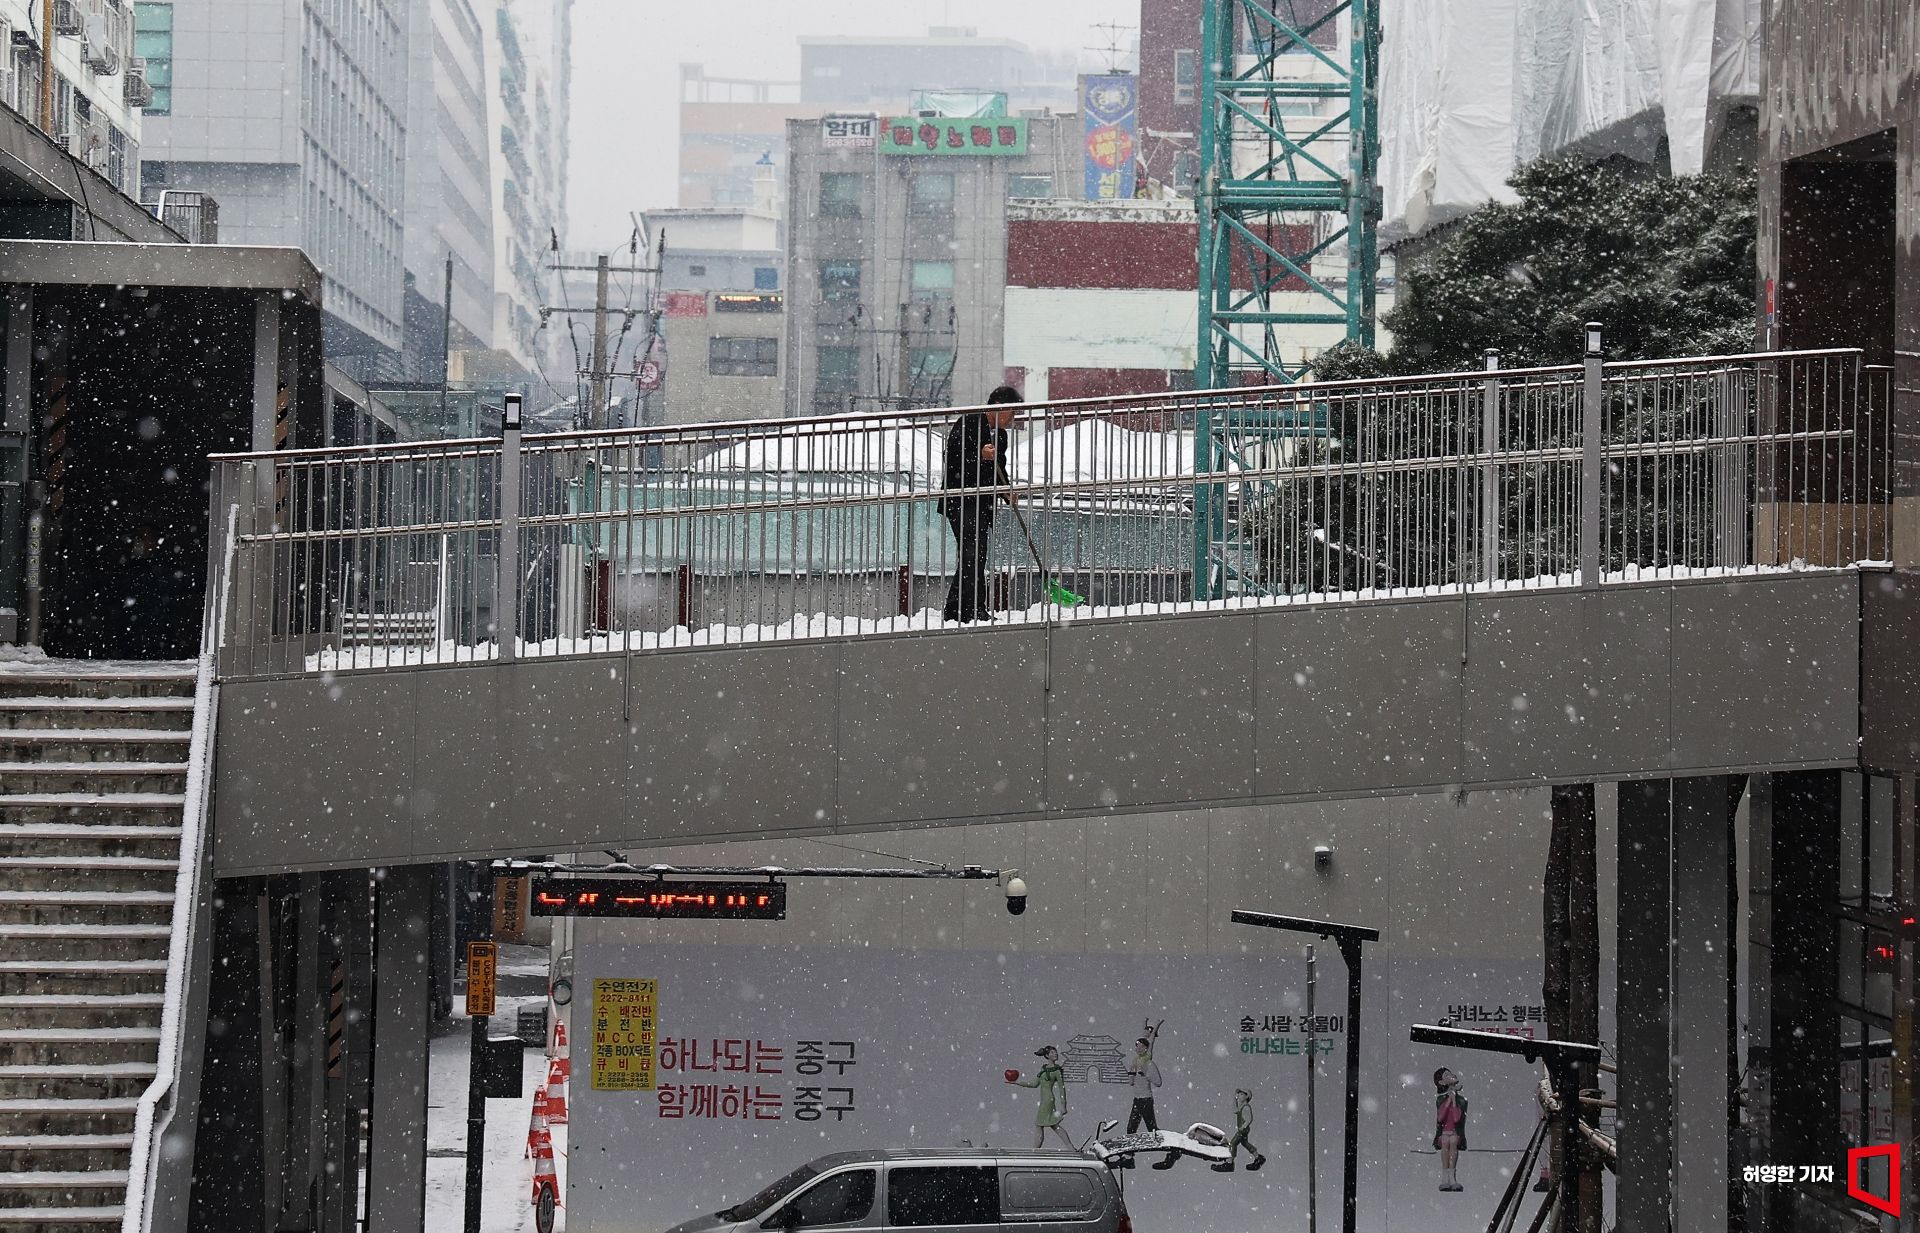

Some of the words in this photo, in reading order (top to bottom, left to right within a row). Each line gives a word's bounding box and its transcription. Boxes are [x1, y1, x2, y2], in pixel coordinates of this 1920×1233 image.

[827, 120, 871, 137] 임대
[597, 981, 653, 993] 수연전기
[1448, 1005, 1508, 1022] 남녀노소
[1240, 1037, 1299, 1055] 하나되는
[659, 1037, 784, 1074] 하나되는
[795, 1040, 856, 1075] 중구
[657, 1083, 783, 1120] 함께하는
[793, 1087, 855, 1122] 중구
